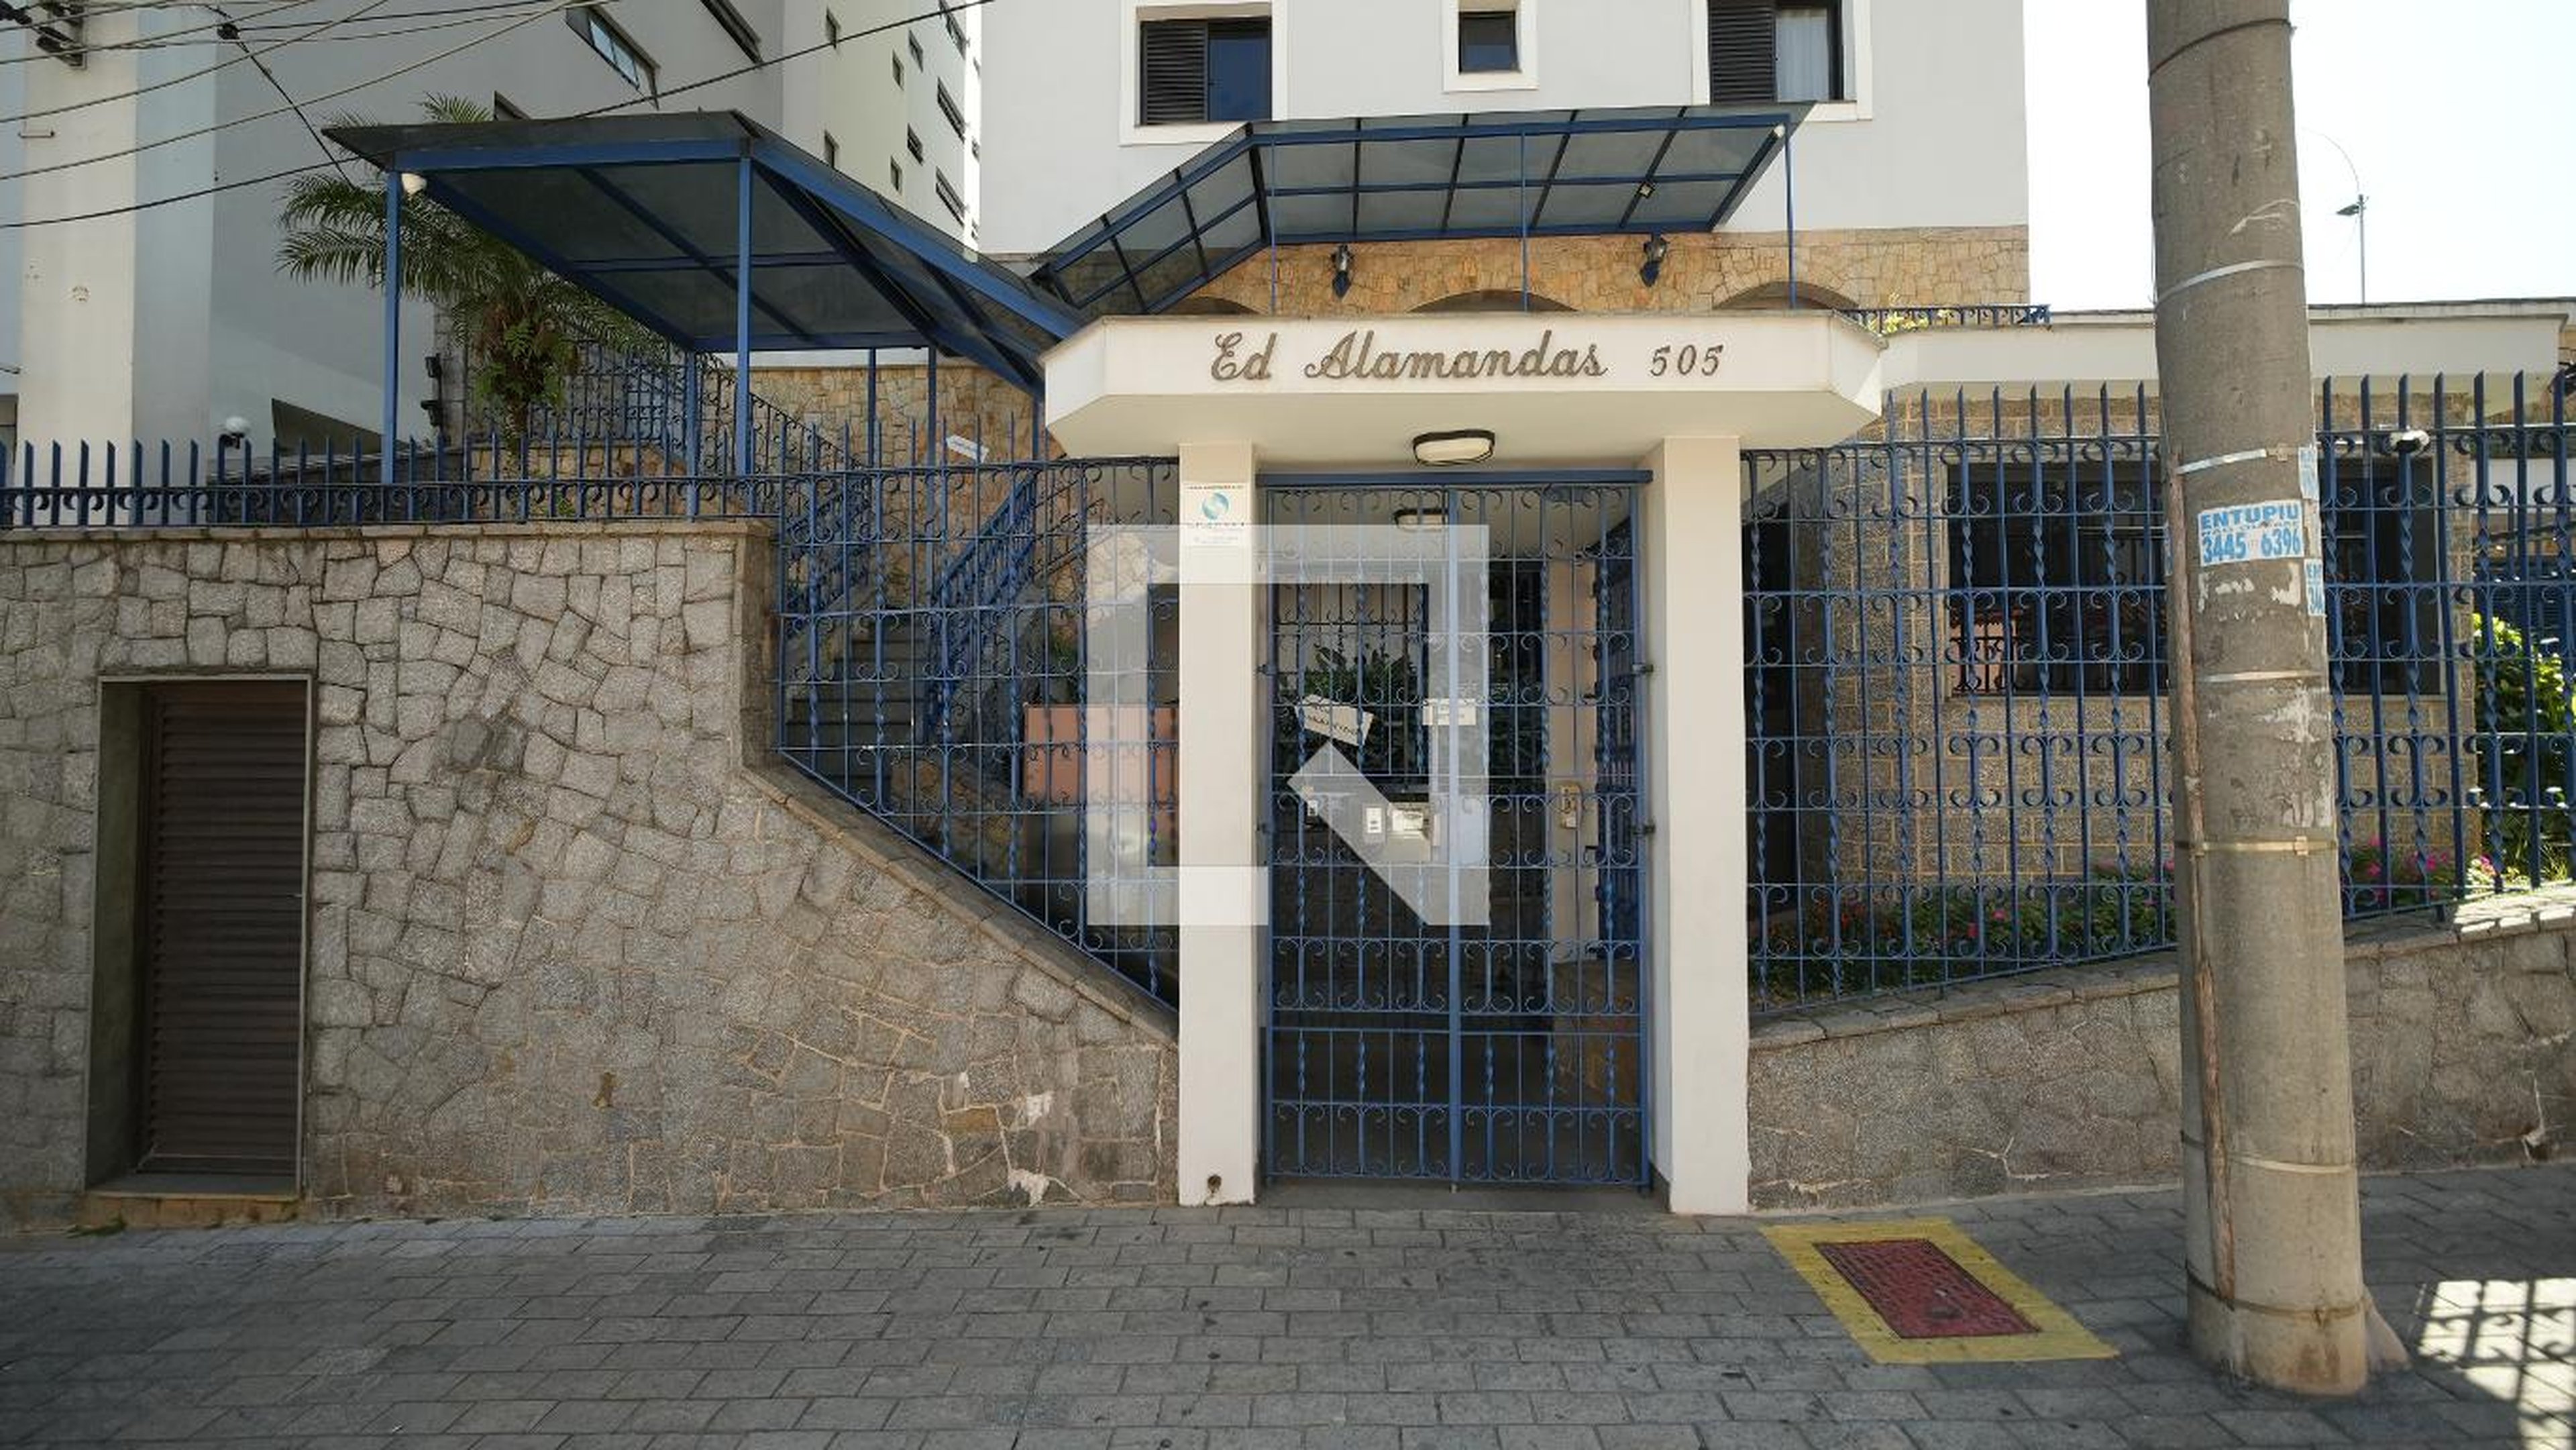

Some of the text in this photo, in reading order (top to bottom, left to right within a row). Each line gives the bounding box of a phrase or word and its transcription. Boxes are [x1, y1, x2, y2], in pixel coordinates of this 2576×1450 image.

[1211, 329, 1723, 380] Ed Alamandas 505
[2201, 505, 2299, 529] ENTUPIU
[2202, 532, 2247, 563] 3445
[2261, 526, 2301, 558] 6396
